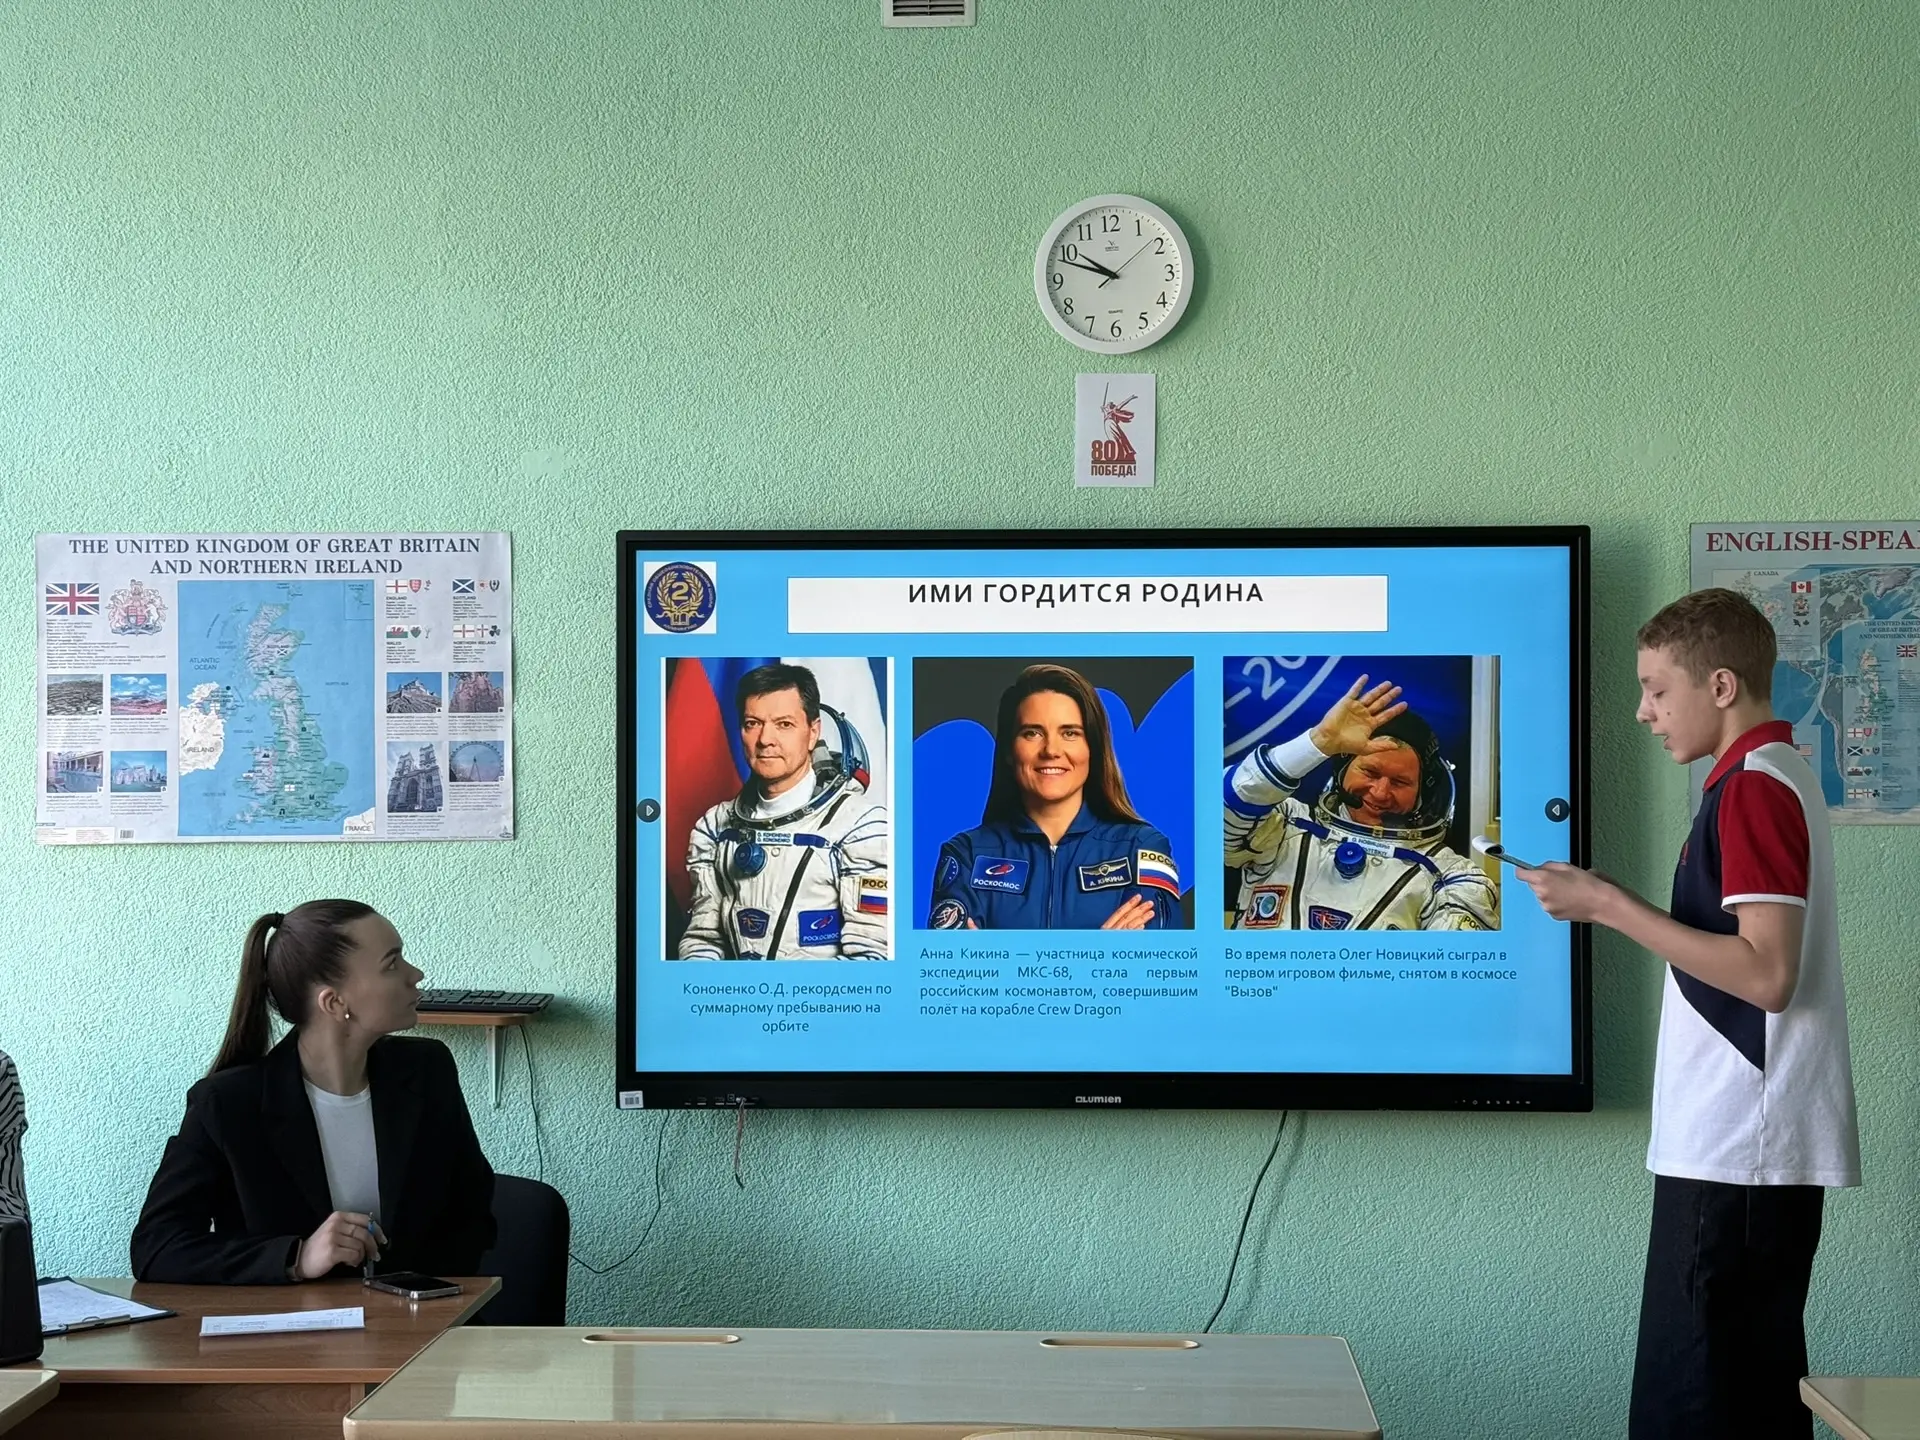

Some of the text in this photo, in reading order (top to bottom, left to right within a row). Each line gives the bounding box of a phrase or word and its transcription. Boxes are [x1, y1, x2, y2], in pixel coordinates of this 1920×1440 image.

[1077, 223, 1093, 242] 11
[1101, 214, 1121, 233] 12
[1135, 218, 1142, 237] 1
[1060, 243, 1078, 261] 10
[1153, 236, 1165, 255] 2
[1053, 272, 1064, 291] 9
[1164, 263, 1175, 282] 3
[1063, 297, 1074, 315] 8
[1156, 291, 1168, 309] 4
[1084, 315, 1095, 333] 7
[1110, 319, 1122, 338] 6
[1138, 311, 1149, 330] 5
[1091, 439, 1118, 461] 80
[1091, 465, 1137, 478] ПОБЕДА!
[69, 538, 480, 554] THE UNITED KINGDOM OF GREAT BRITAIN
[1706, 529, 1920, 552] ENGLISH-SPEA
[150, 559, 403, 574] AND NORTHERN IRELAND
[671, 581, 689, 601] 2
[909, 583, 1264, 608] ИМИ ГОРДИТСЯ РОДИНА
[973, 878, 1020, 891] РОСКОСМОС
[919, 948, 954, 960] Анна
[960, 948, 1010, 960] Кикина
[1035, 950, 1105, 962] участница
[1111, 947, 1198, 960] космической
[1225, 947, 1507, 963] Во время полета Олег Новицкий сыграл в
[919, 966, 1198, 981] экспедиции МКС-68, стала первым
[1224, 965, 1518, 983] первом игровом фильме, снятом в космосе
[683, 982, 892, 998] Кононенко О.Д. рекордсмен по
[920, 985, 1198, 1000] российским космонавтом, совершившим
[1224, 984, 1279, 998] "Вызов"
[690, 1000, 881, 1017] суммарному пребыванию на
[920, 1002, 1122, 1019] полёт на корабле Crew Dragon
[761, 1019, 810, 1035] орбите
